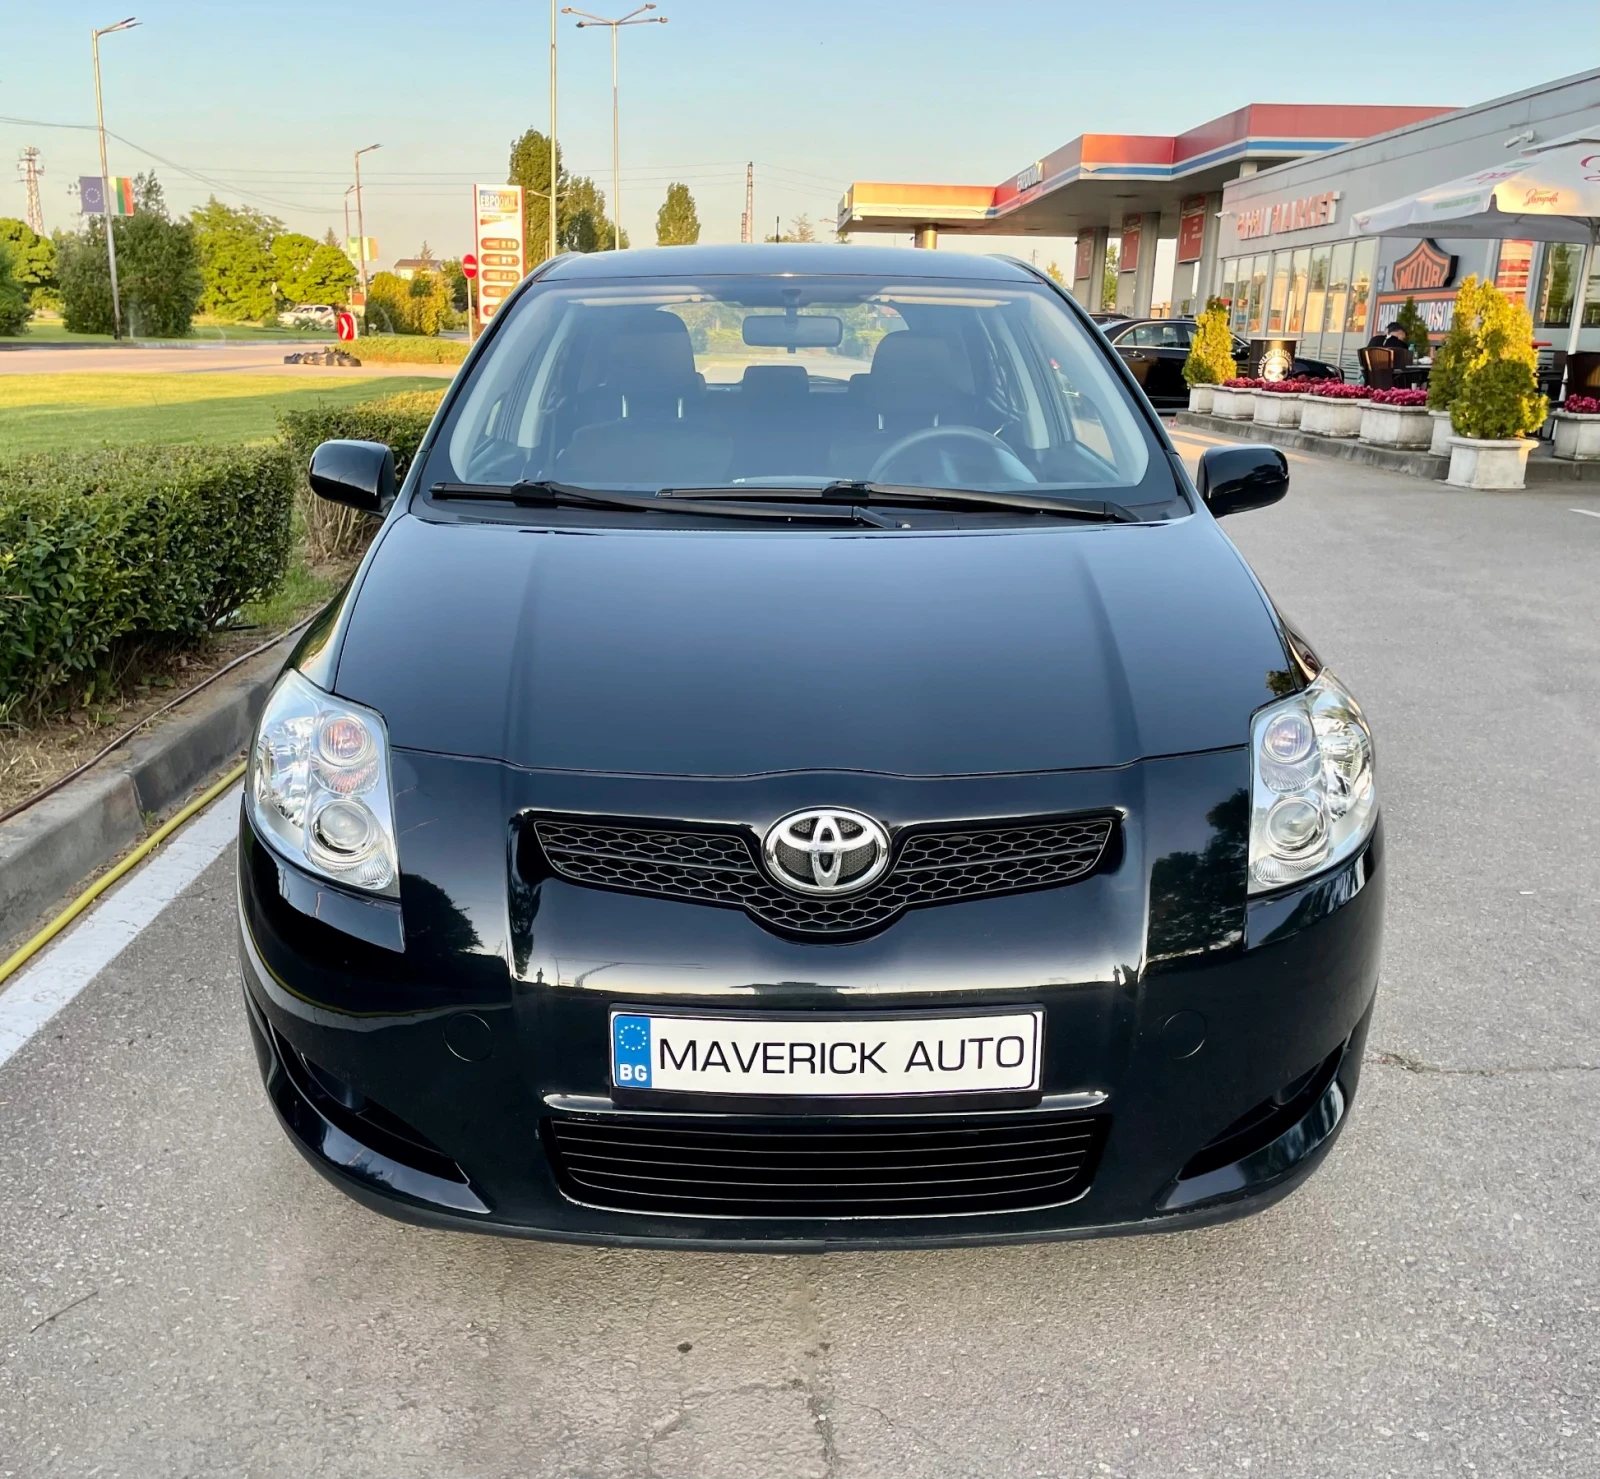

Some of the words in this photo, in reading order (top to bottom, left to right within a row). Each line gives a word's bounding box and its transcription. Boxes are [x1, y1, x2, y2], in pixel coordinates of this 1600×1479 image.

[1399, 252, 1441, 290] MOTOR
[619, 1063, 648, 1082] BG
[658, 1037, 888, 1075] MAVERICK
[904, 1035, 1026, 1073] AUTO
